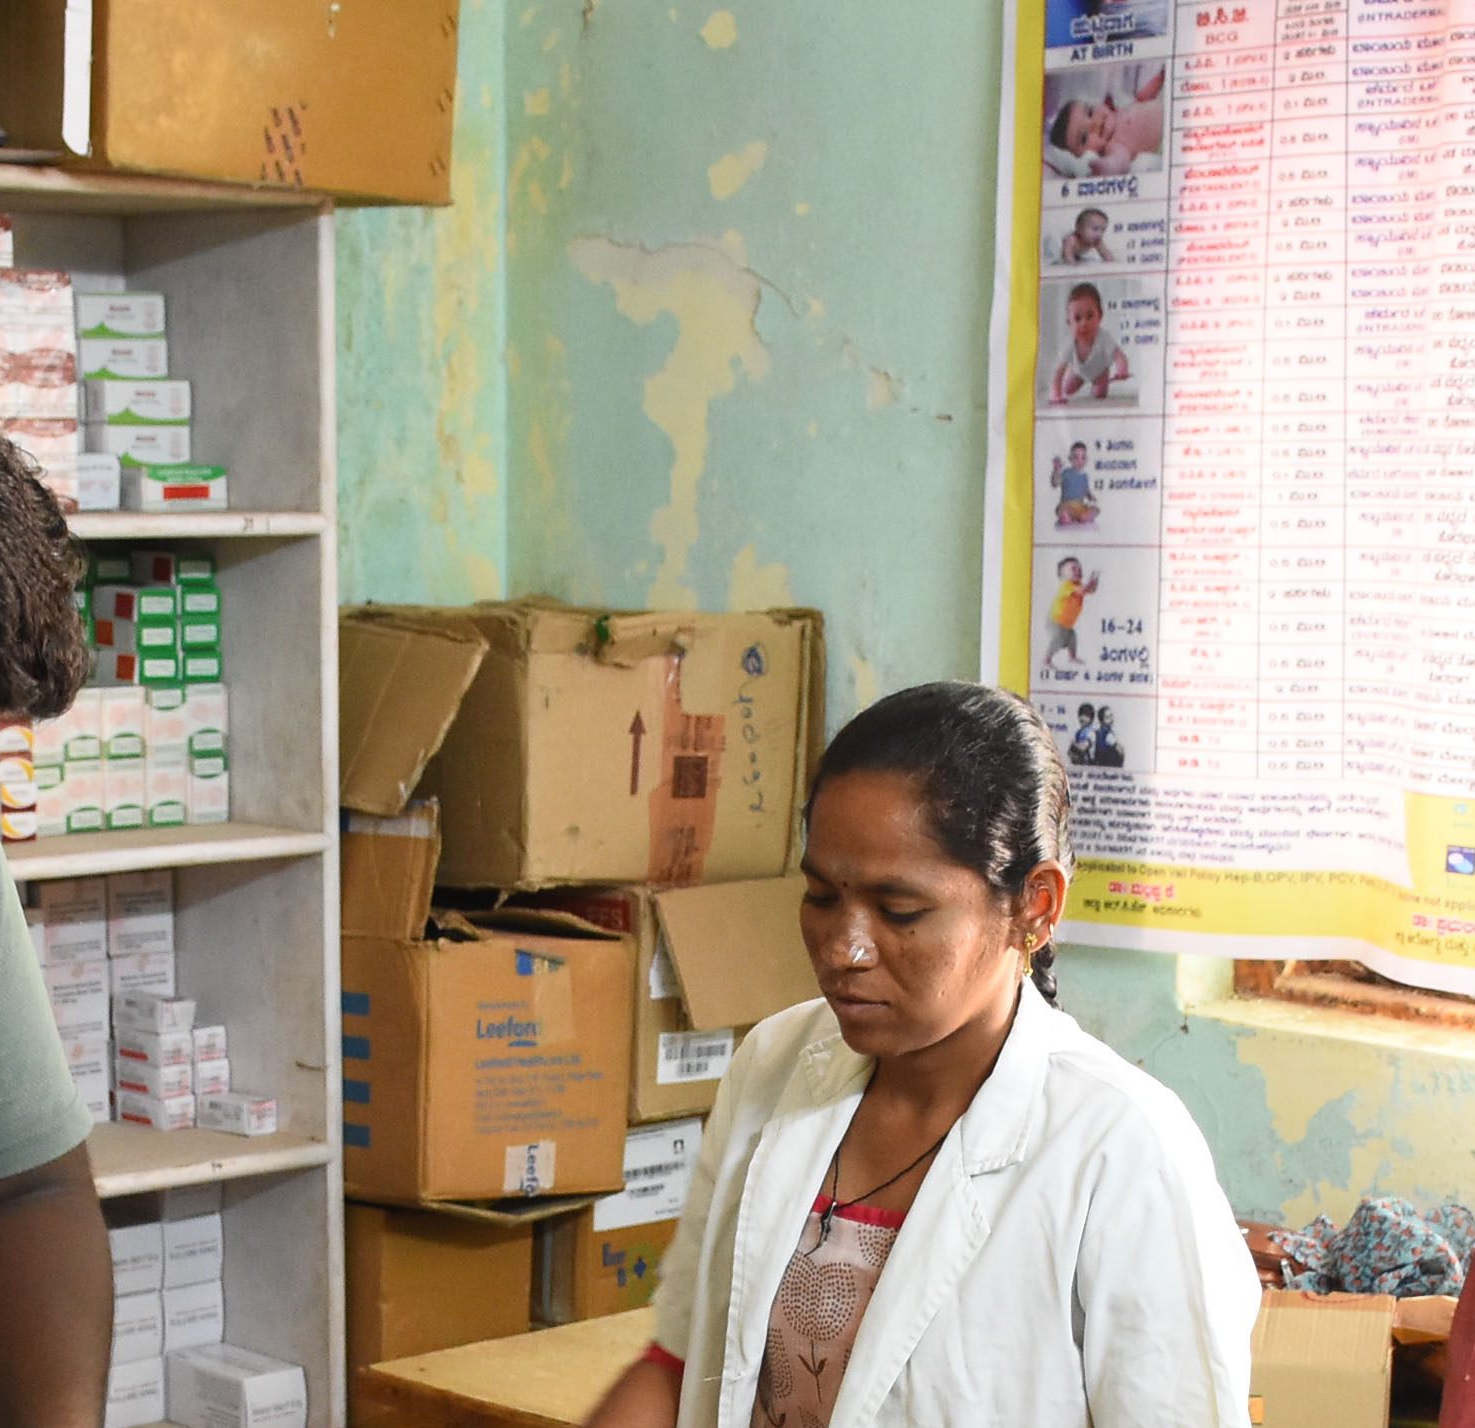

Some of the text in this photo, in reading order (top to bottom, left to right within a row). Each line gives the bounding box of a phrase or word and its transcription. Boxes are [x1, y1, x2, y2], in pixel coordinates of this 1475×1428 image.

[1205, 32, 1238, 45] BCG
[1071, 43, 1133, 61] AT BIRTH
[1101, 618, 1143, 634] 16-24
[1139, 864, 1167, 877] Open
[1189, 868, 1221, 883] Policy
[1422, 895, 1441, 908] not
